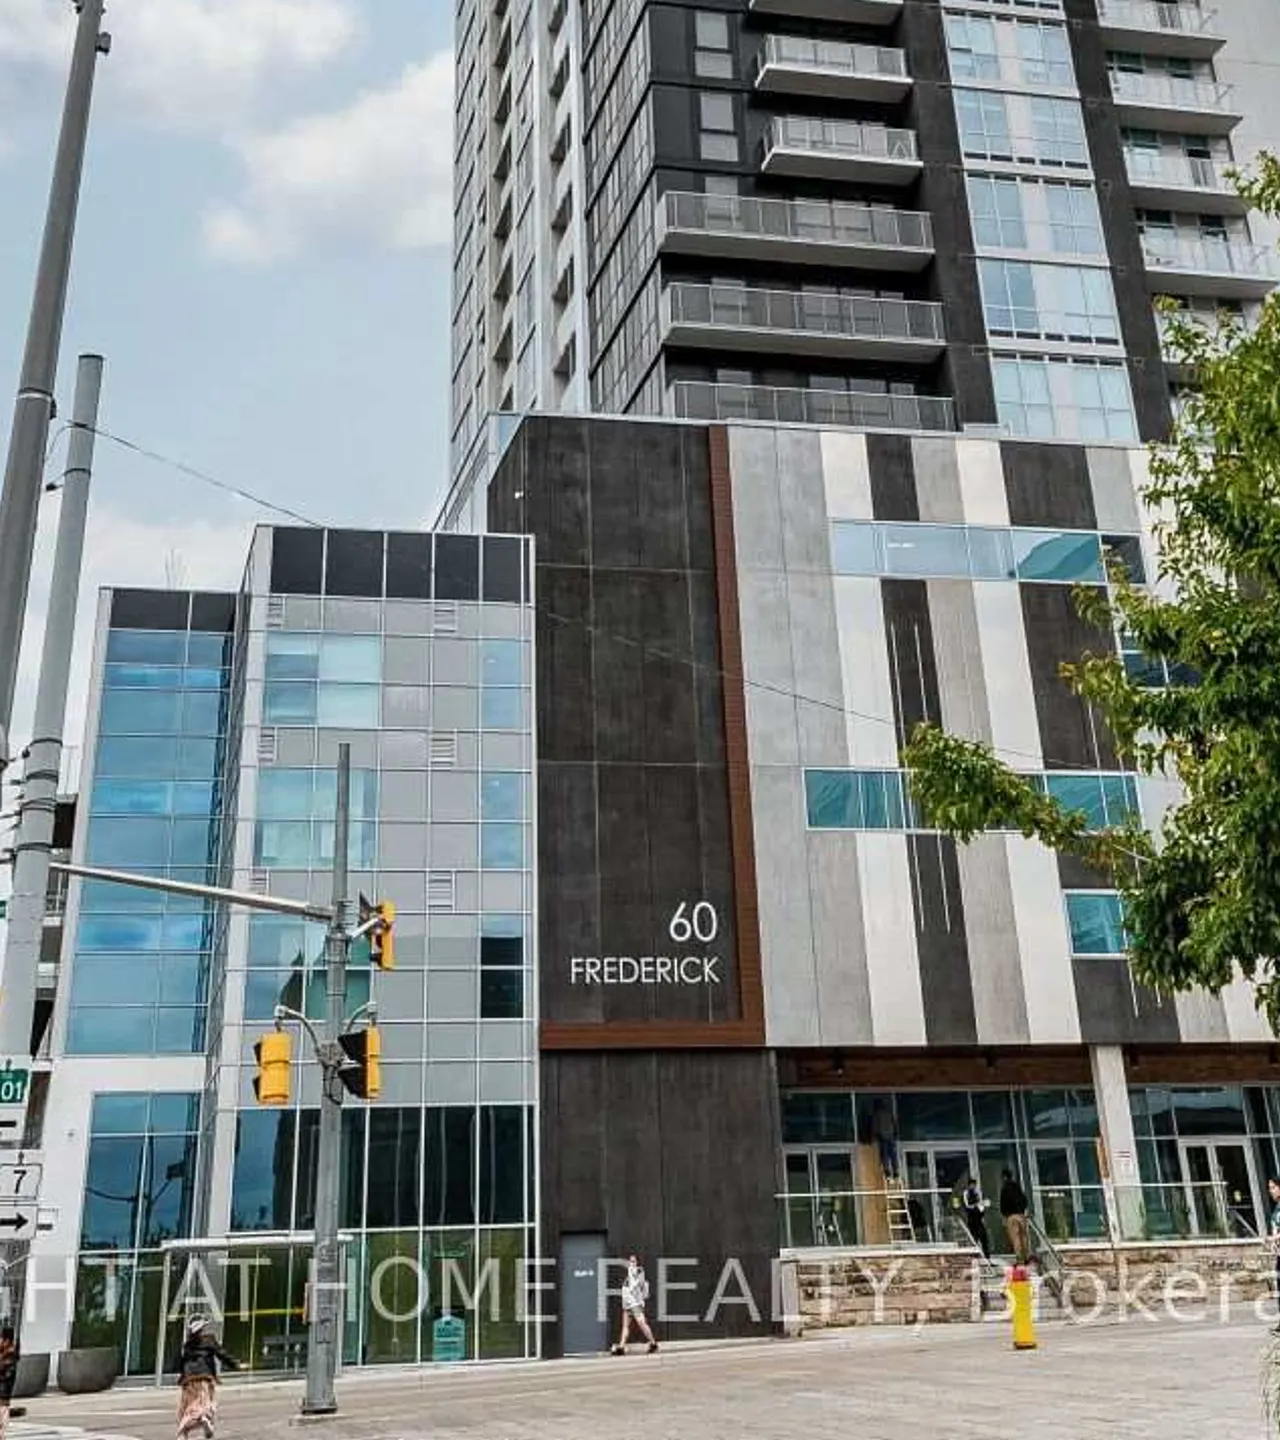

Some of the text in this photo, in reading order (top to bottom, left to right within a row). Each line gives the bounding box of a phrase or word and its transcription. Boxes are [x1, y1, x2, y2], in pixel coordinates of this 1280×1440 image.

[669, 901, 718, 942] 60
[570, 957, 721, 984] FREDERICK
[13, 1169, 27, 1194] 7
